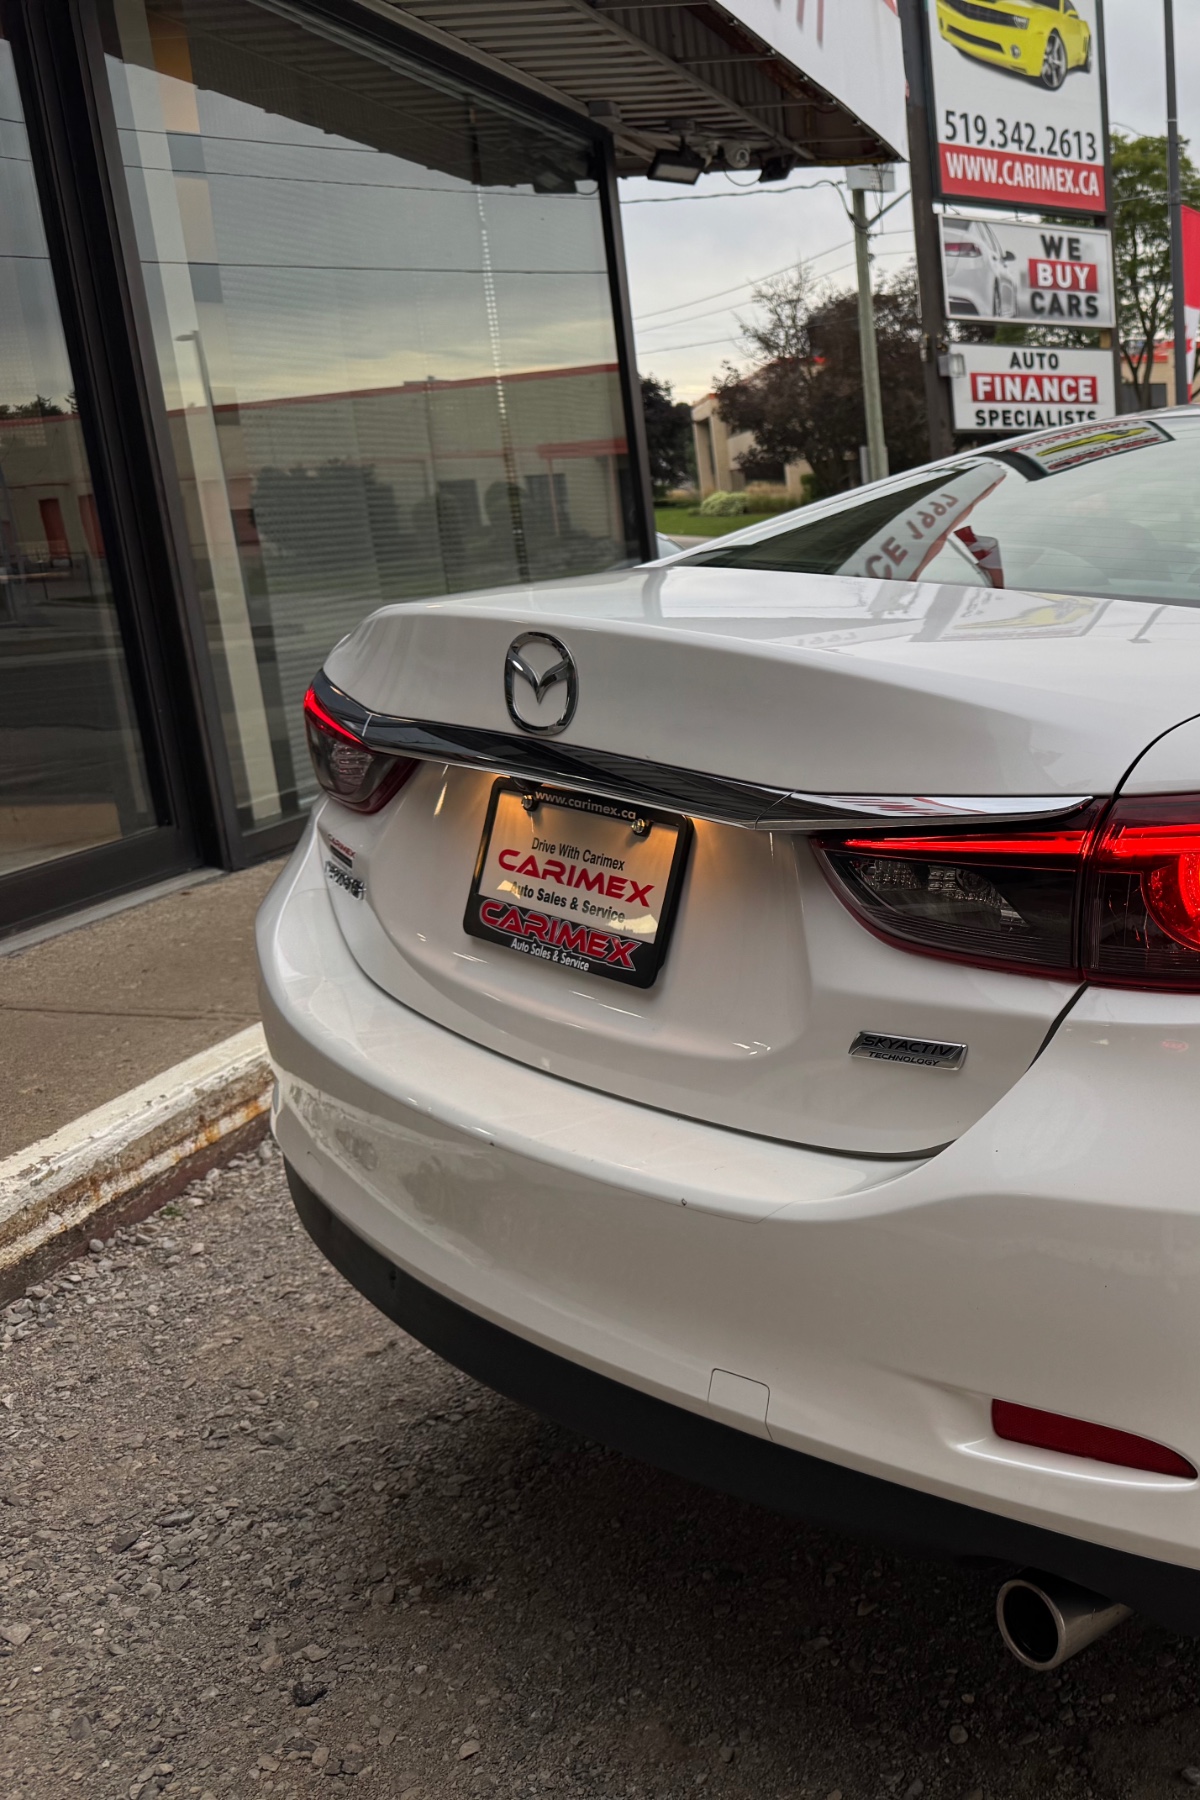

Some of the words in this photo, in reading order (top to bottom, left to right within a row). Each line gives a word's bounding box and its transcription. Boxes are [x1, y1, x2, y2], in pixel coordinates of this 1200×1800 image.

[944, 109, 1098, 162] 519.342.2613
[945, 151, 1100, 197] WWW.CARIMEX.CA
[1040, 234, 1082, 262] WE
[1036, 263, 1091, 290] BUY
[1030, 291, 1099, 318] CARS
[1009, 352, 1059, 370] AUTO
[975, 375, 1093, 403] FINANCE
[975, 409, 1097, 428] SPECIALISTS
[535, 790, 637, 820] www.carimex.ca
[531, 837, 556, 854] Drive
[559, 843, 580, 860] With
[582, 849, 625, 871] Carimex
[498, 849, 655, 907] CARIMEX
[511, 881, 534, 899] Auto
[537, 887, 567, 907] Sales
[570, 897, 578, 911] &
[582, 900, 626, 923] Service
[480, 900, 640, 969] CARIMEX
[511, 938, 530, 953] Auto
[531, 944, 551, 961] Sales
[552, 950, 559, 961] &
[560, 952, 590, 971] Service
[862, 1035, 954, 1056] SKYACTIV
[868, 1050, 941, 1067] TECHNOLOGY
